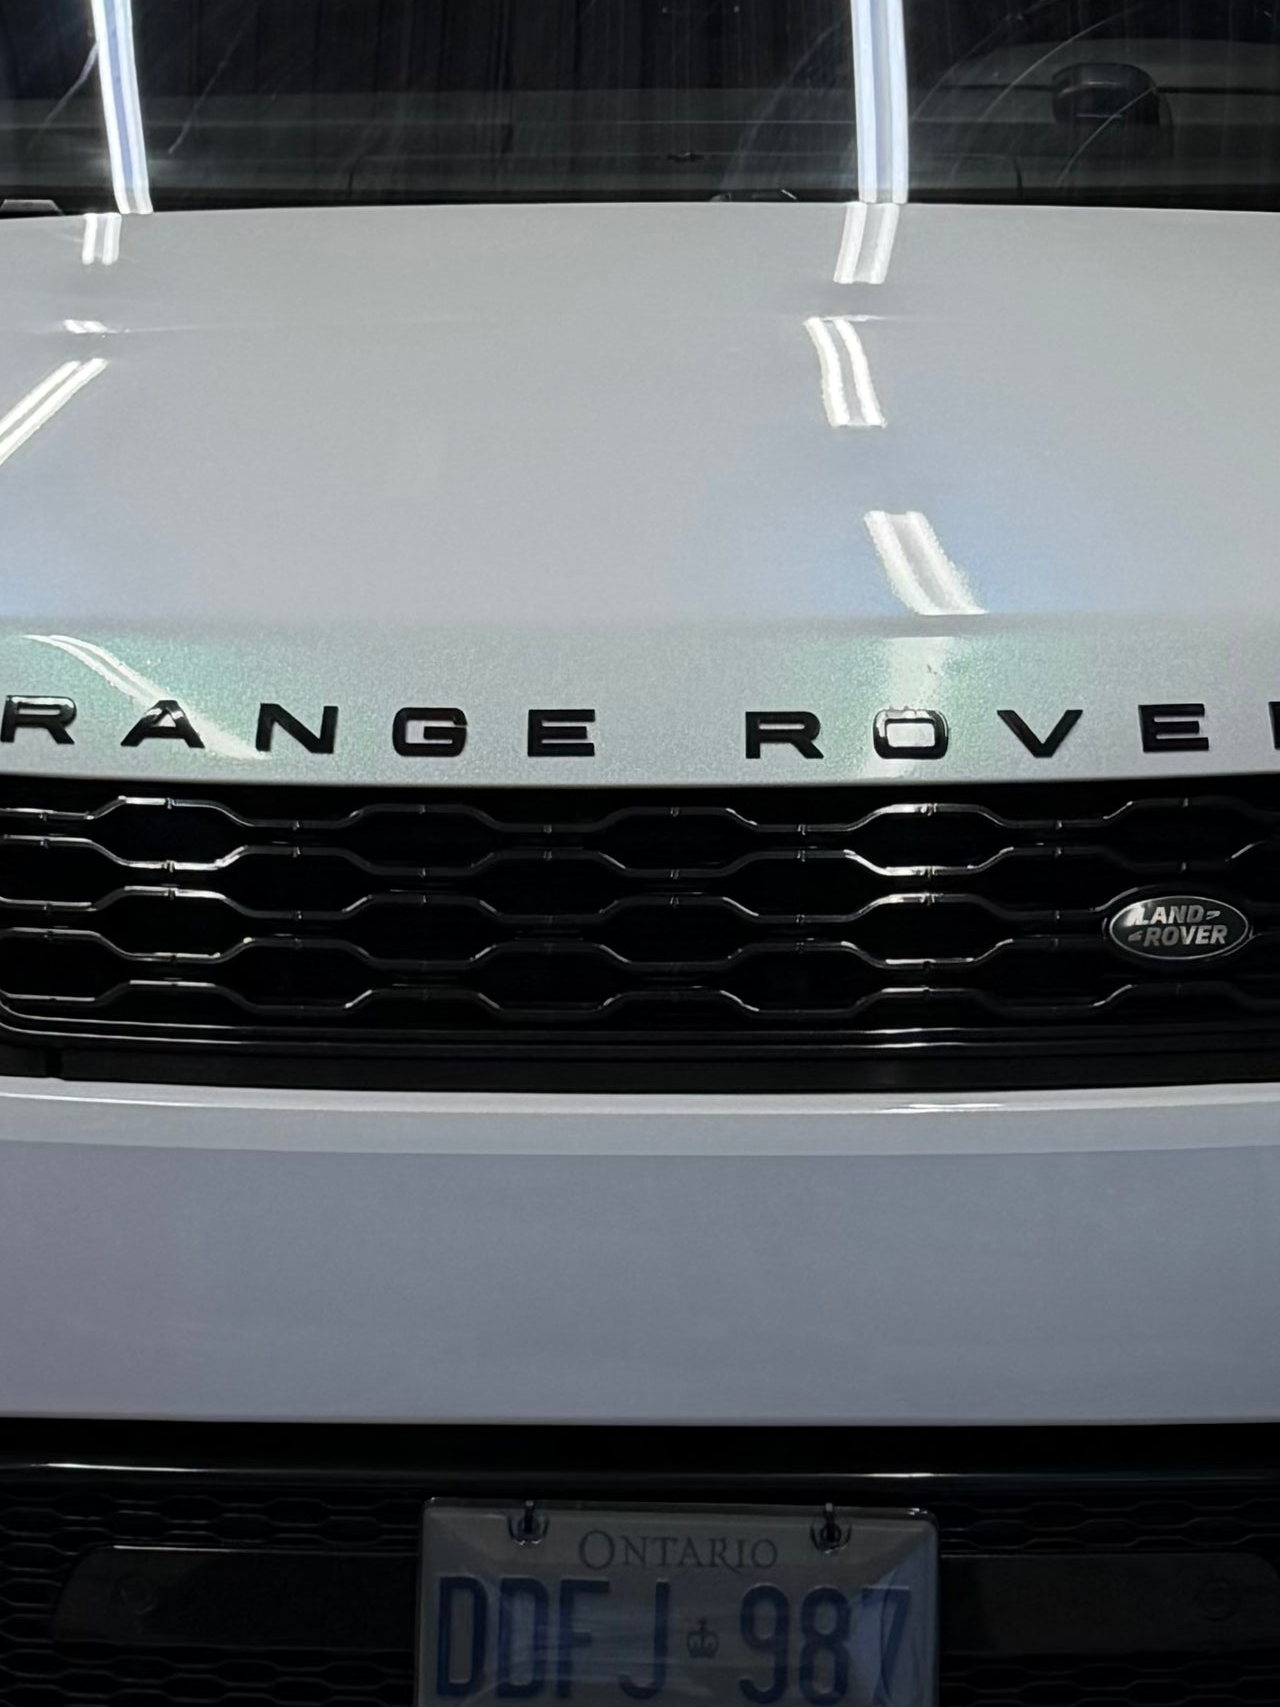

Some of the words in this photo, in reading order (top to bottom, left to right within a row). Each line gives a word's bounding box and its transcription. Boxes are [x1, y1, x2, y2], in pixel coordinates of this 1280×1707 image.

[1, 694, 596, 757] RANGE
[1133, 905, 1204, 925] LAND
[1144, 925, 1228, 947] ROVER
[436, 1576, 671, 1700] DDFJ
[739, 1583, 912, 1707] 987
